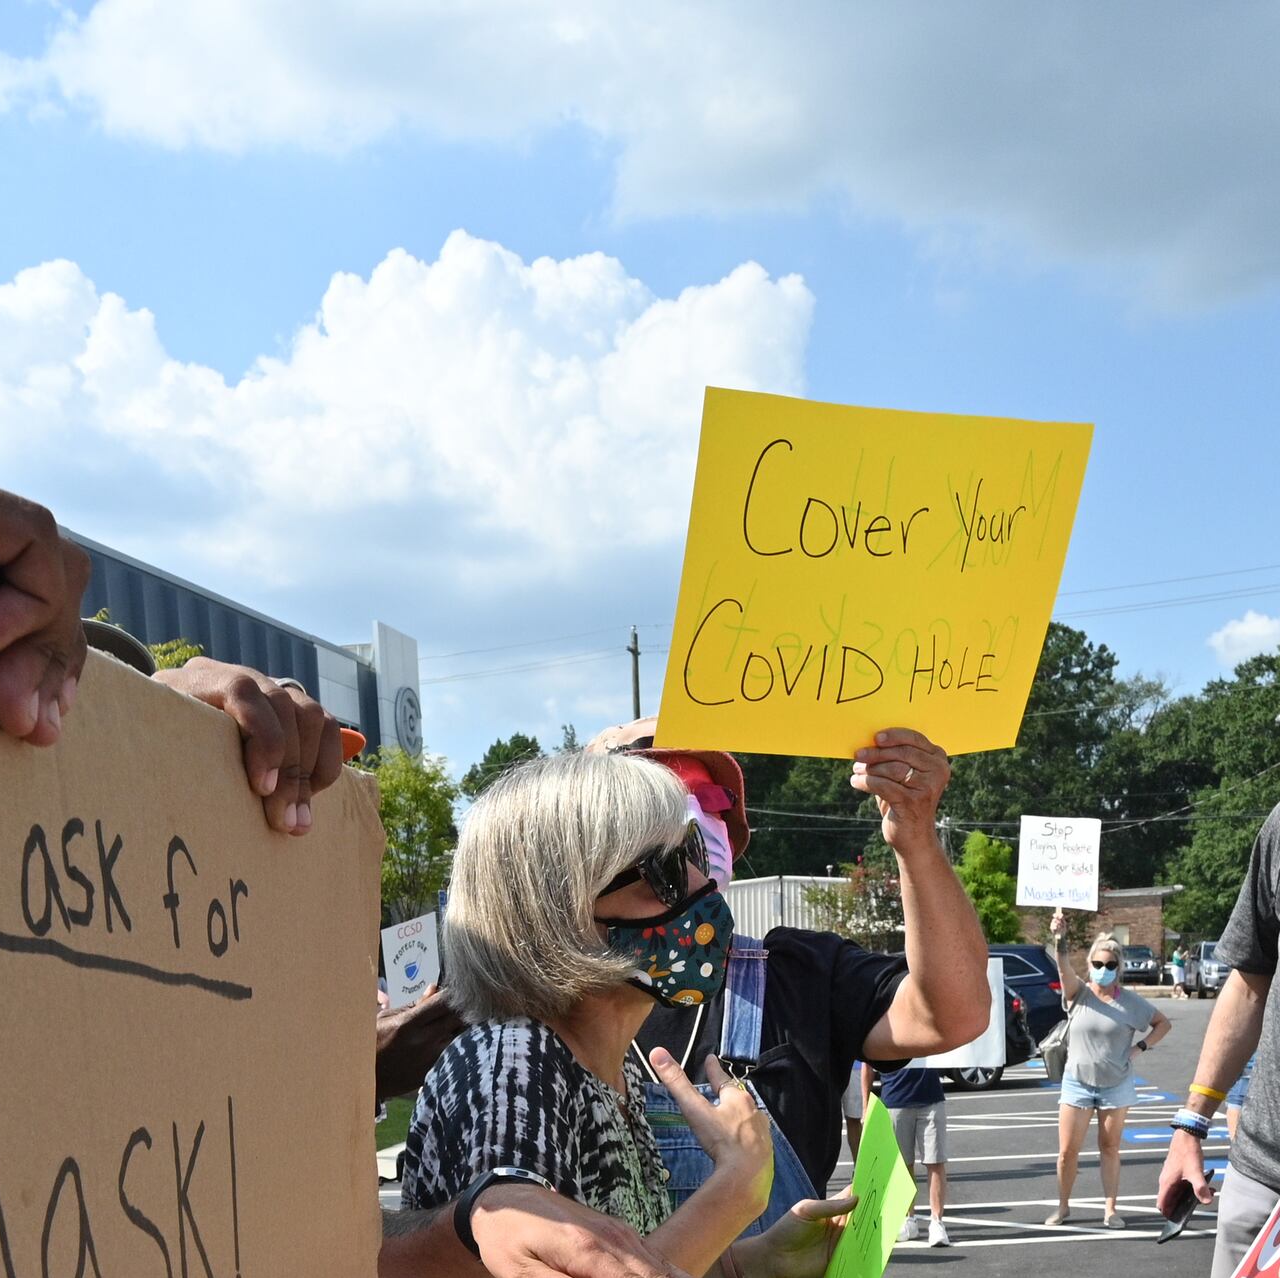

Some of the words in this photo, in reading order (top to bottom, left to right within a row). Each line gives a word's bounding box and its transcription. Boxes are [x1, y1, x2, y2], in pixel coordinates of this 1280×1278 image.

[743, 438, 930, 558] Cover
[955, 478, 1027, 573] Your
[683, 598, 885, 706] COVID
[908, 634, 999, 704] HOLE
[1041, 822, 1074, 840] Stop
[20, 817, 133, 937] ask
[161, 834, 250, 958] for
[393, 940, 416, 965] PROTECT
[397, 921, 423, 939] CCSD
